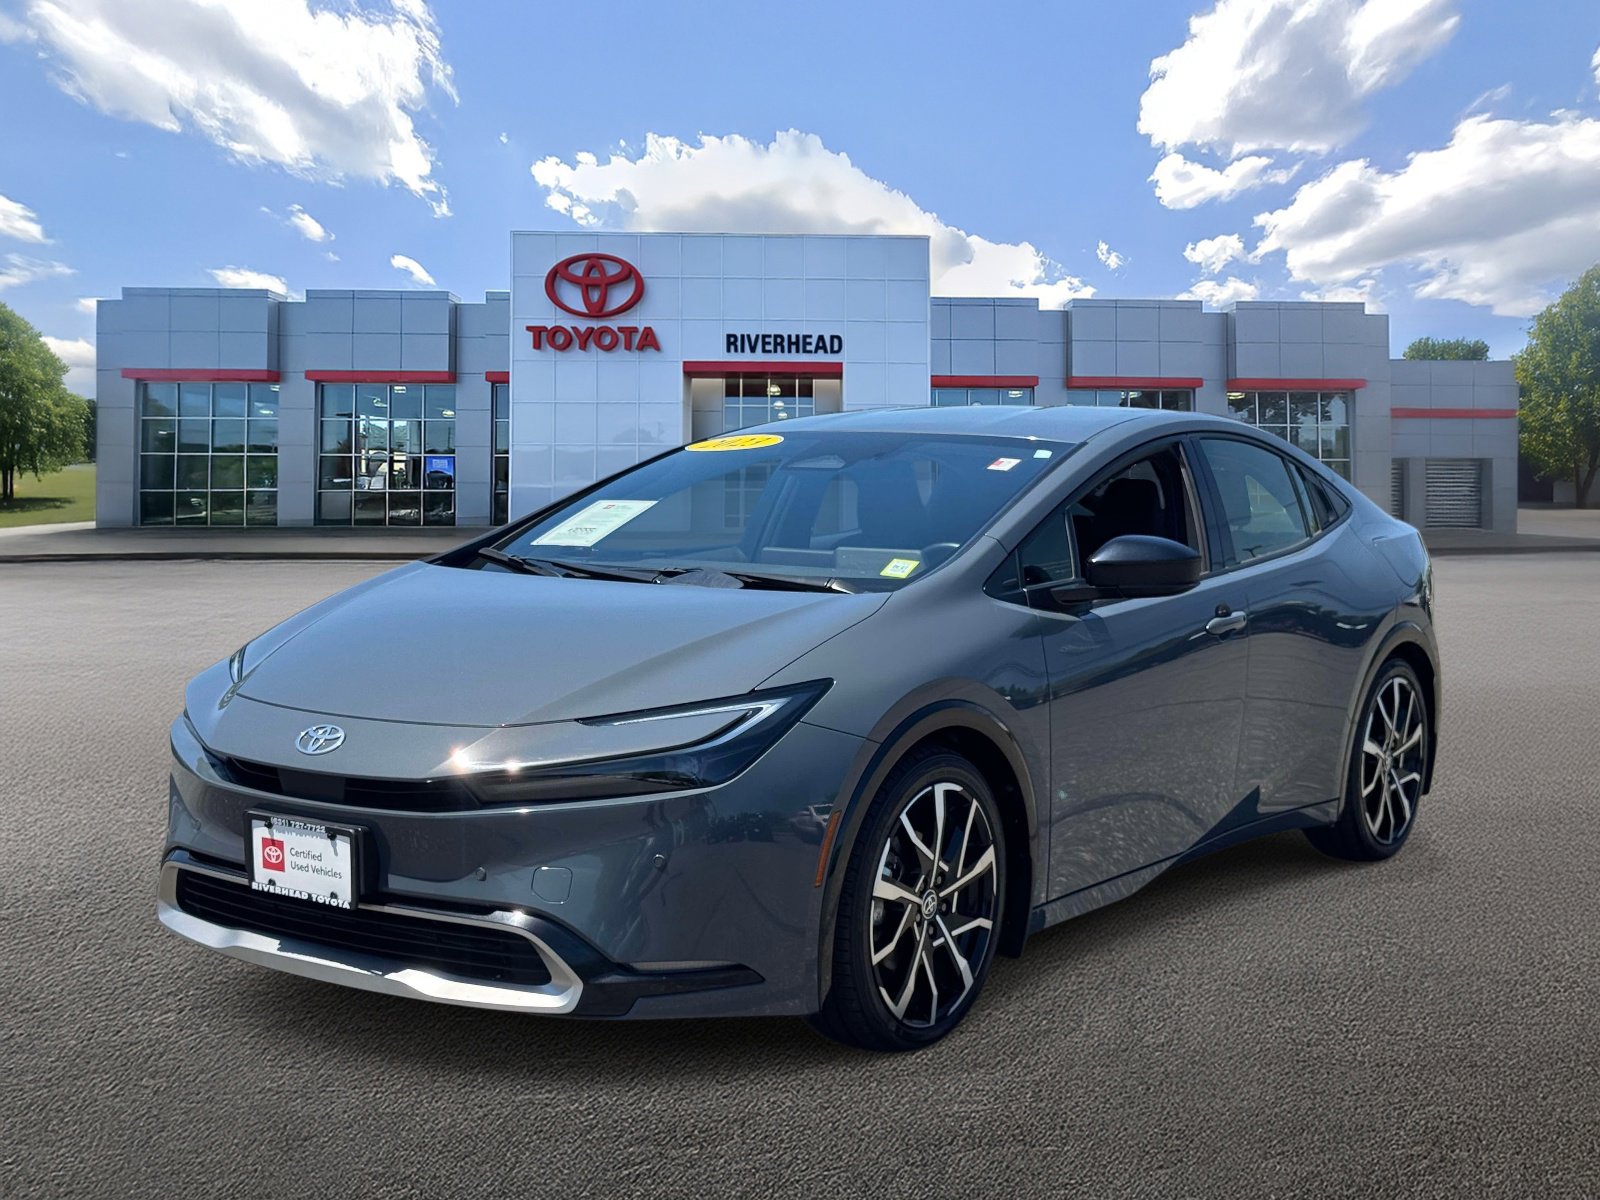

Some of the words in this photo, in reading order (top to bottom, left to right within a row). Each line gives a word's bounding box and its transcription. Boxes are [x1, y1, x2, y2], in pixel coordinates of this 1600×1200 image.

[526, 325, 661, 352] TOYOTA
[726, 333, 843, 354] RIVERHEAD
[290, 848, 322, 861] Certified
[290, 861, 309, 872] Used
[311, 865, 342, 879] Vehicles
[252, 882, 308, 899] RIVERHEAD
[311, 894, 350, 909] TOYOTA
